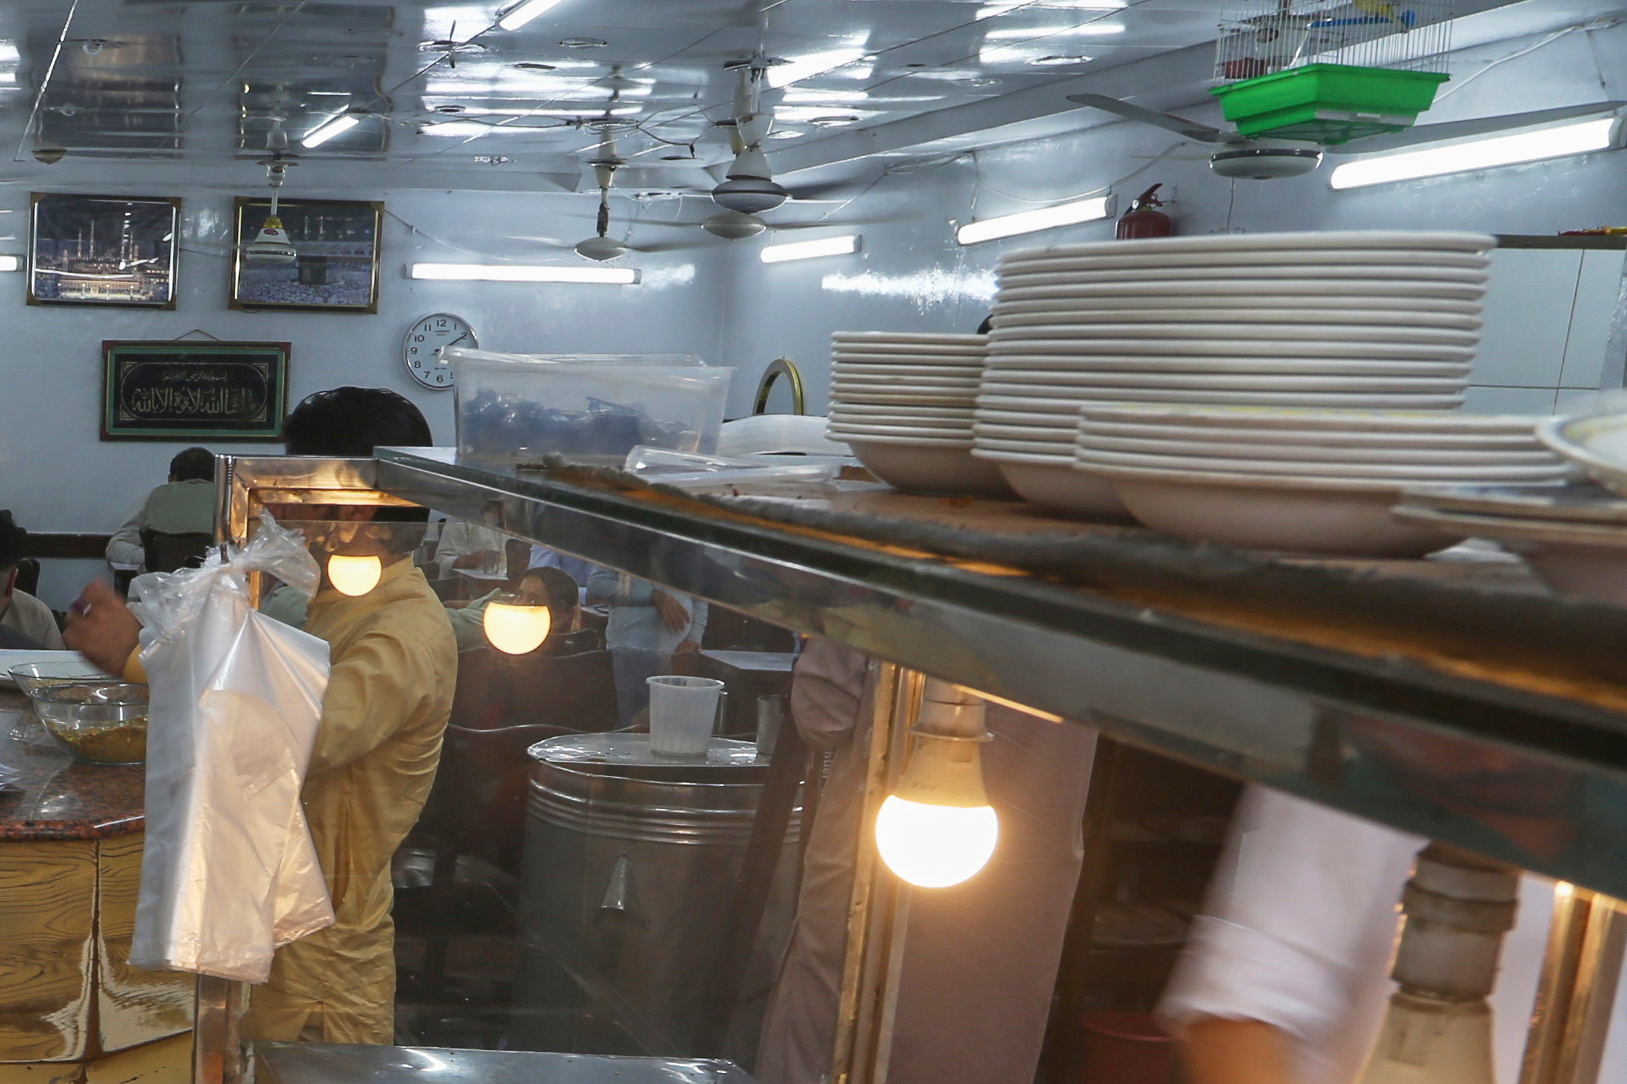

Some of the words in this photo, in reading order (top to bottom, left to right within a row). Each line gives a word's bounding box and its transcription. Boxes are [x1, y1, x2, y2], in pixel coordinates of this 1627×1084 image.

[424, 324, 432, 332] 11
[436, 319, 447, 328] 12
[414, 334, 425, 343] 10
[410, 346, 418, 355] 9
[414, 360, 421, 369] 8
[423, 371, 430, 379] 7
[436, 374, 444, 383] 6
